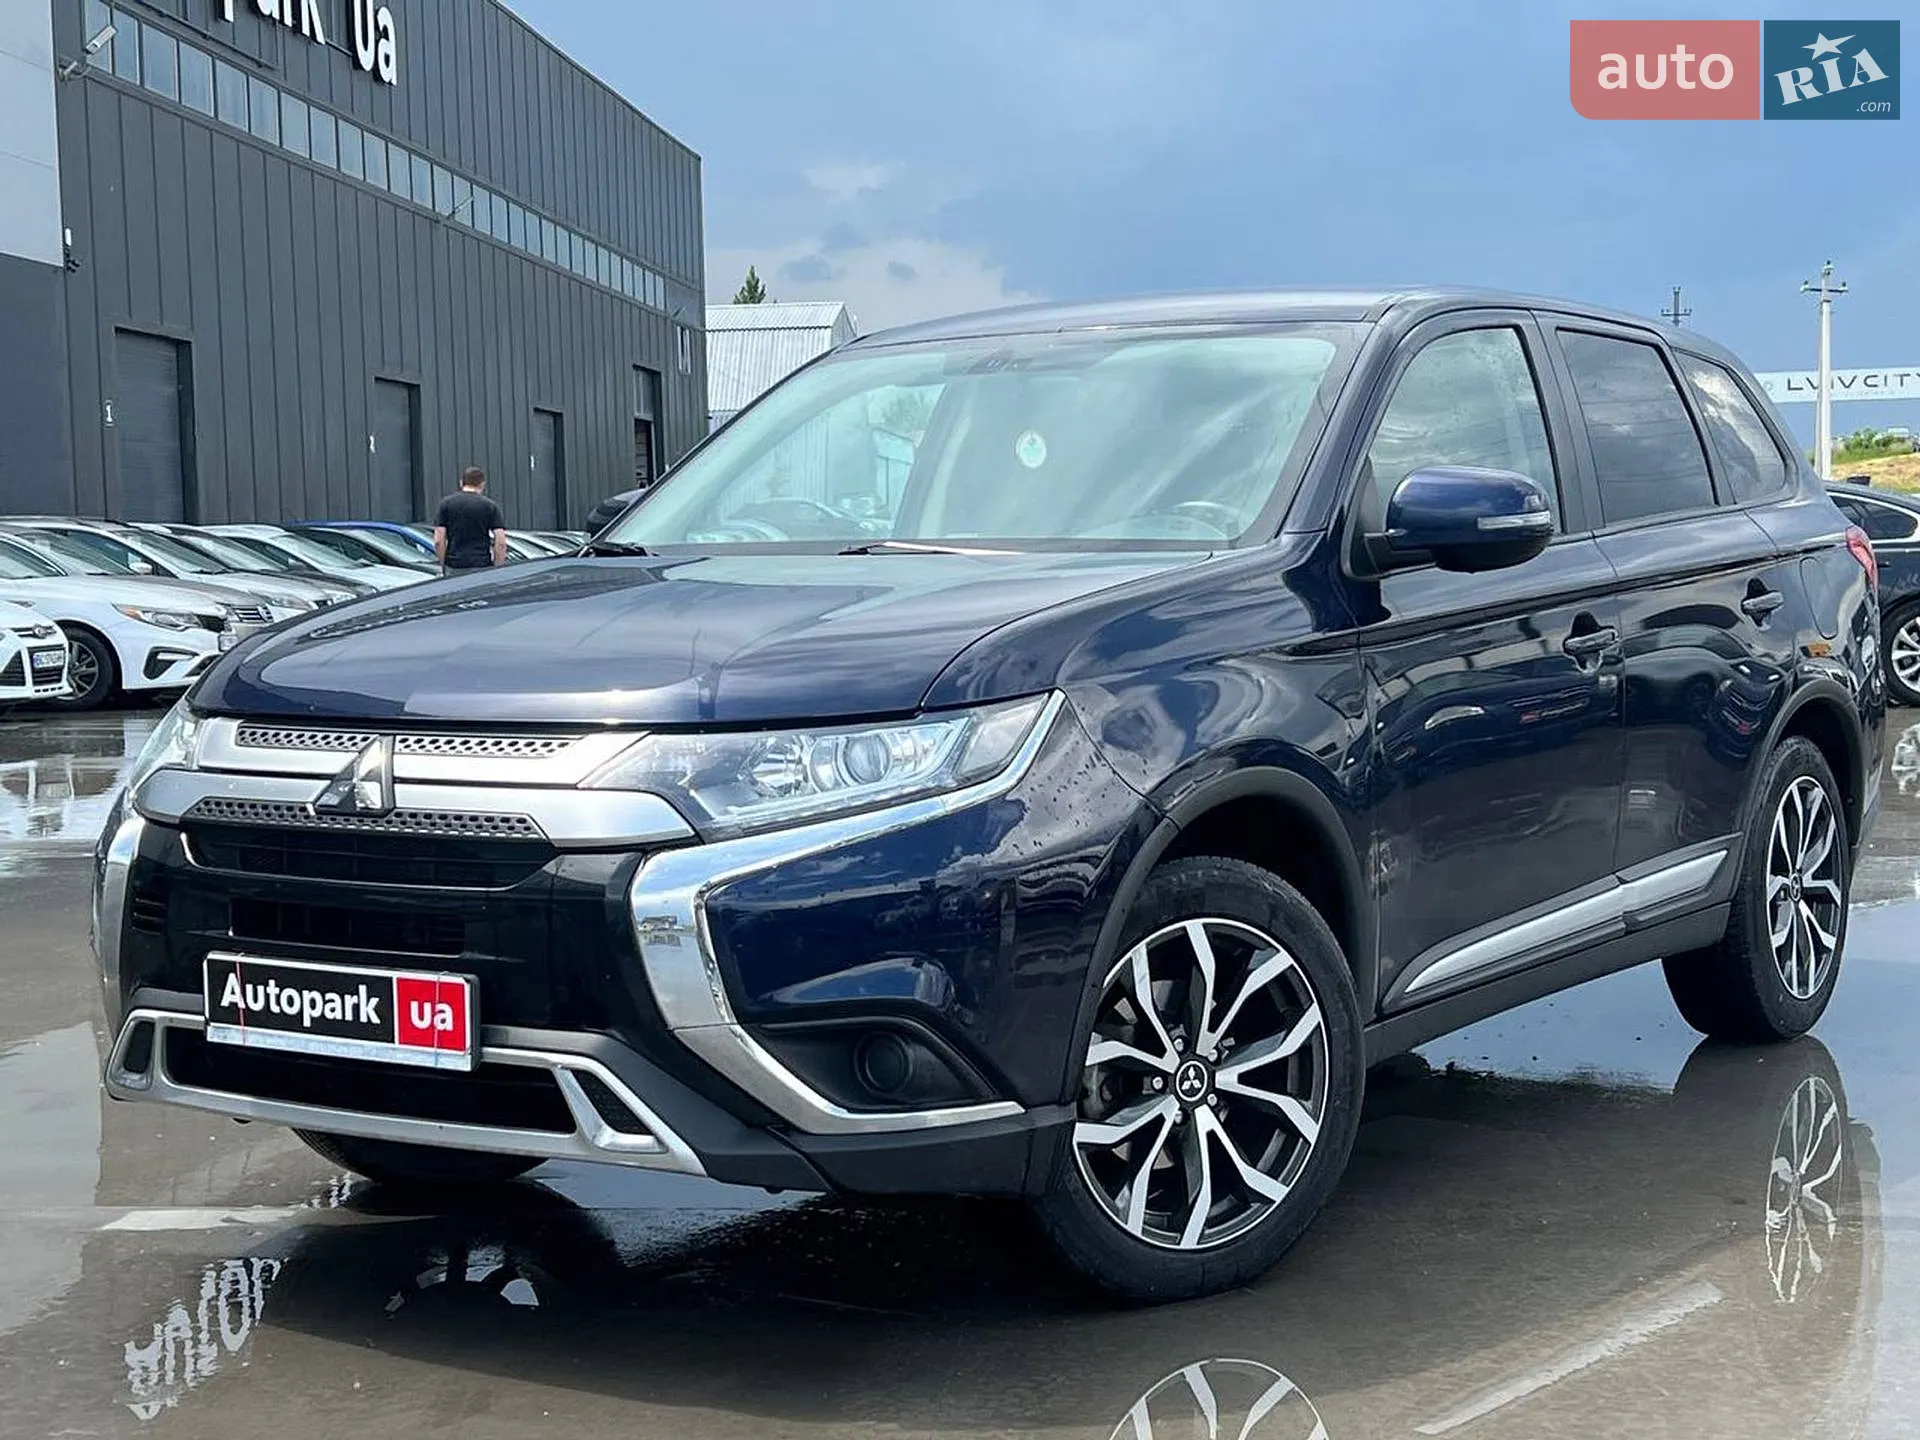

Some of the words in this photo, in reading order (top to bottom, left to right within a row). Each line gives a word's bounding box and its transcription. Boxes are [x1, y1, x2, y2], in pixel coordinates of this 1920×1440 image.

[1787, 373, 1920, 391] LVIVCIT
[220, 972, 381, 1028] Autopark
[409, 1000, 454, 1031] ua
